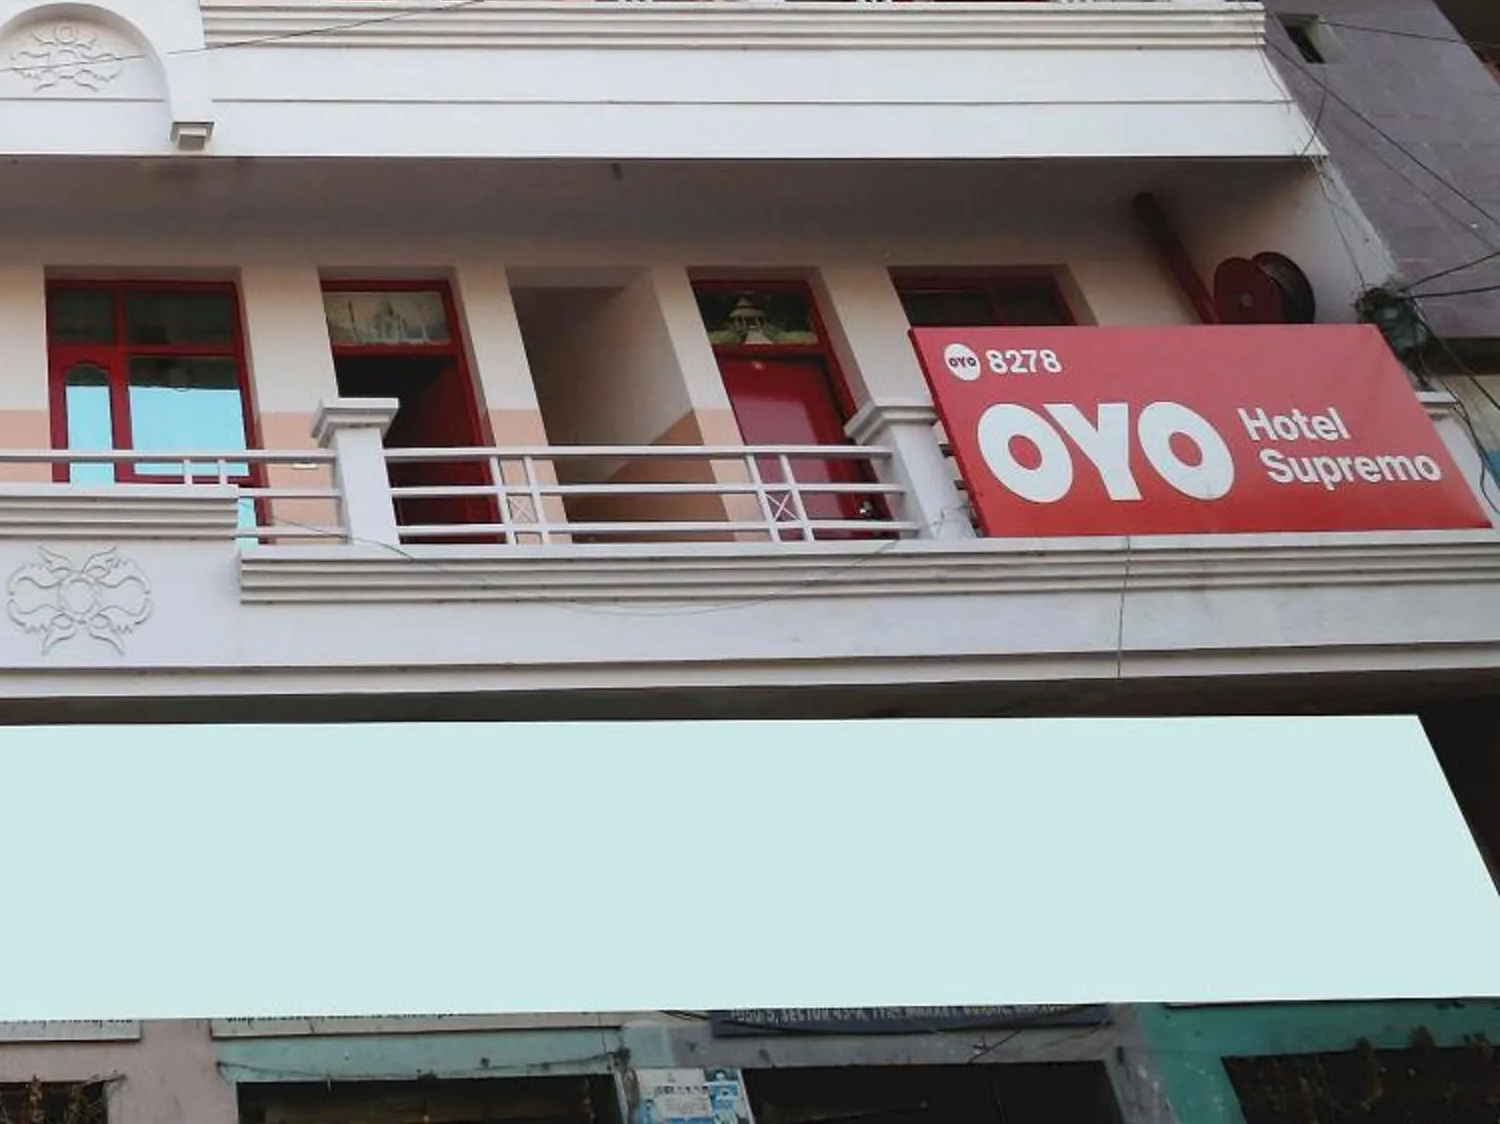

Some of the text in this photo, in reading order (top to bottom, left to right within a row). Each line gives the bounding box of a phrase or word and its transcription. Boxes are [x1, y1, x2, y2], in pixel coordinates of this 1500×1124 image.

[985, 349, 1062, 374] 8278
[1237, 407, 1351, 441] Hotel
[977, 402, 1235, 503] OYO
[1259, 448, 1442, 491] Supremo
